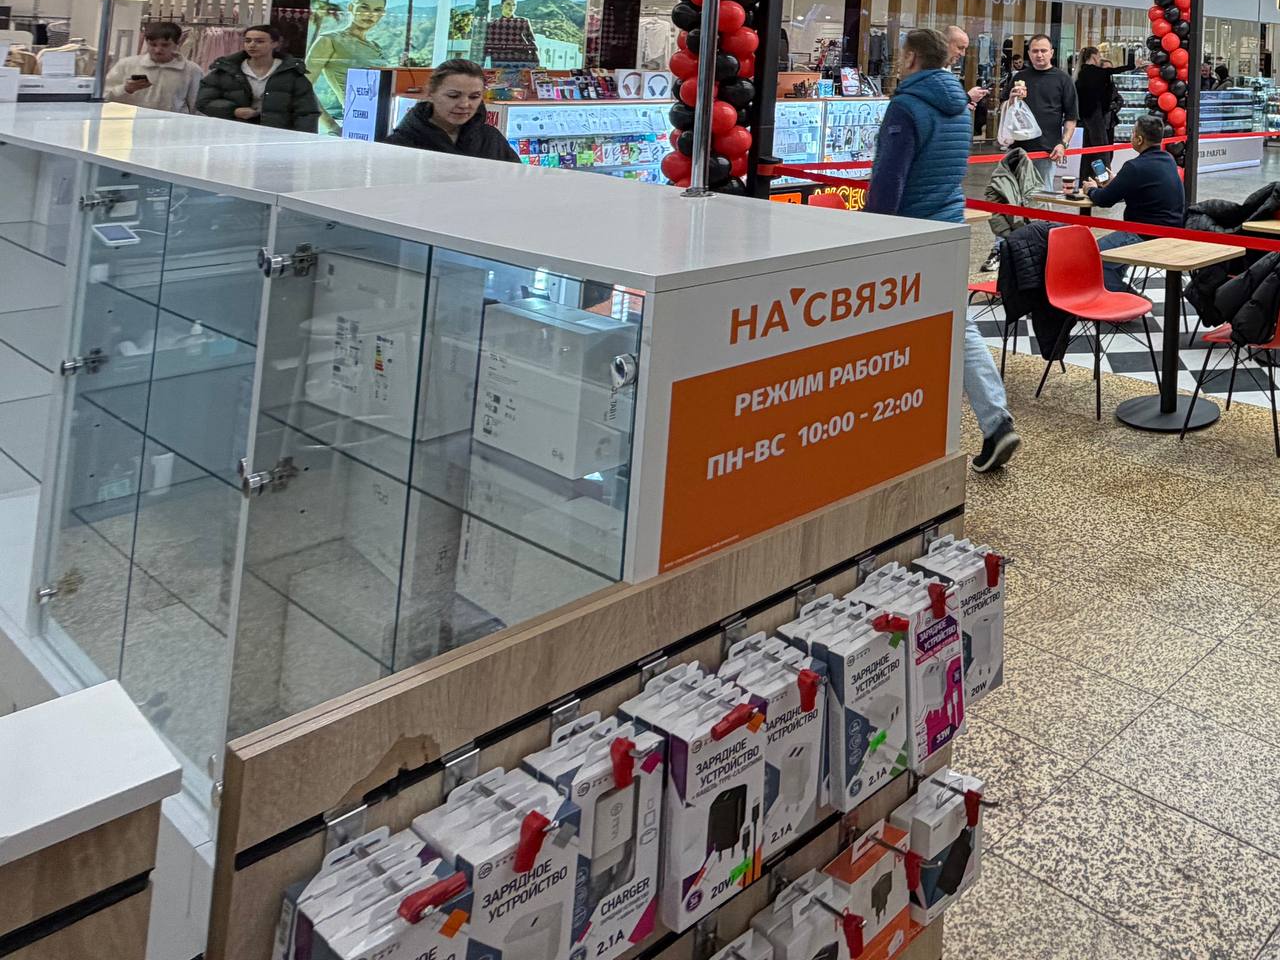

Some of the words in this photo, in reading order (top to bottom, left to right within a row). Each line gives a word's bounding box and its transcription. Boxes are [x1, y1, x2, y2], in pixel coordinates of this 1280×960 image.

[729, 300, 790, 345] НА
[803, 272, 921, 327] СВЯЗИ
[734, 370, 824, 417] РЕЖИМ
[829, 346, 911, 390] РАБОТЫ
[706, 434, 786, 481] ПН-ВС
[798, 411, 855, 448] 10:00
[872, 389, 924, 423] 22:00
[963, 591, 1000, 618] УСТРОЙСТВО
[851, 652, 890, 685] ЗАРЯДНОЕ
[855, 658, 900, 696] УСТРОЙСТВО
[970, 681, 988, 697] 20W
[767, 709, 819, 746] УСТРОЙСТВО
[695, 737, 748, 776] ЗАРЯДНОЕ
[700, 745, 760, 788] УСТРОЙСТВО
[482, 858, 553, 909] ЗАРЯДНОЕ
[488, 866, 568, 924] УСТРОЙСТВО
[601, 877, 650, 917] CHARGER
